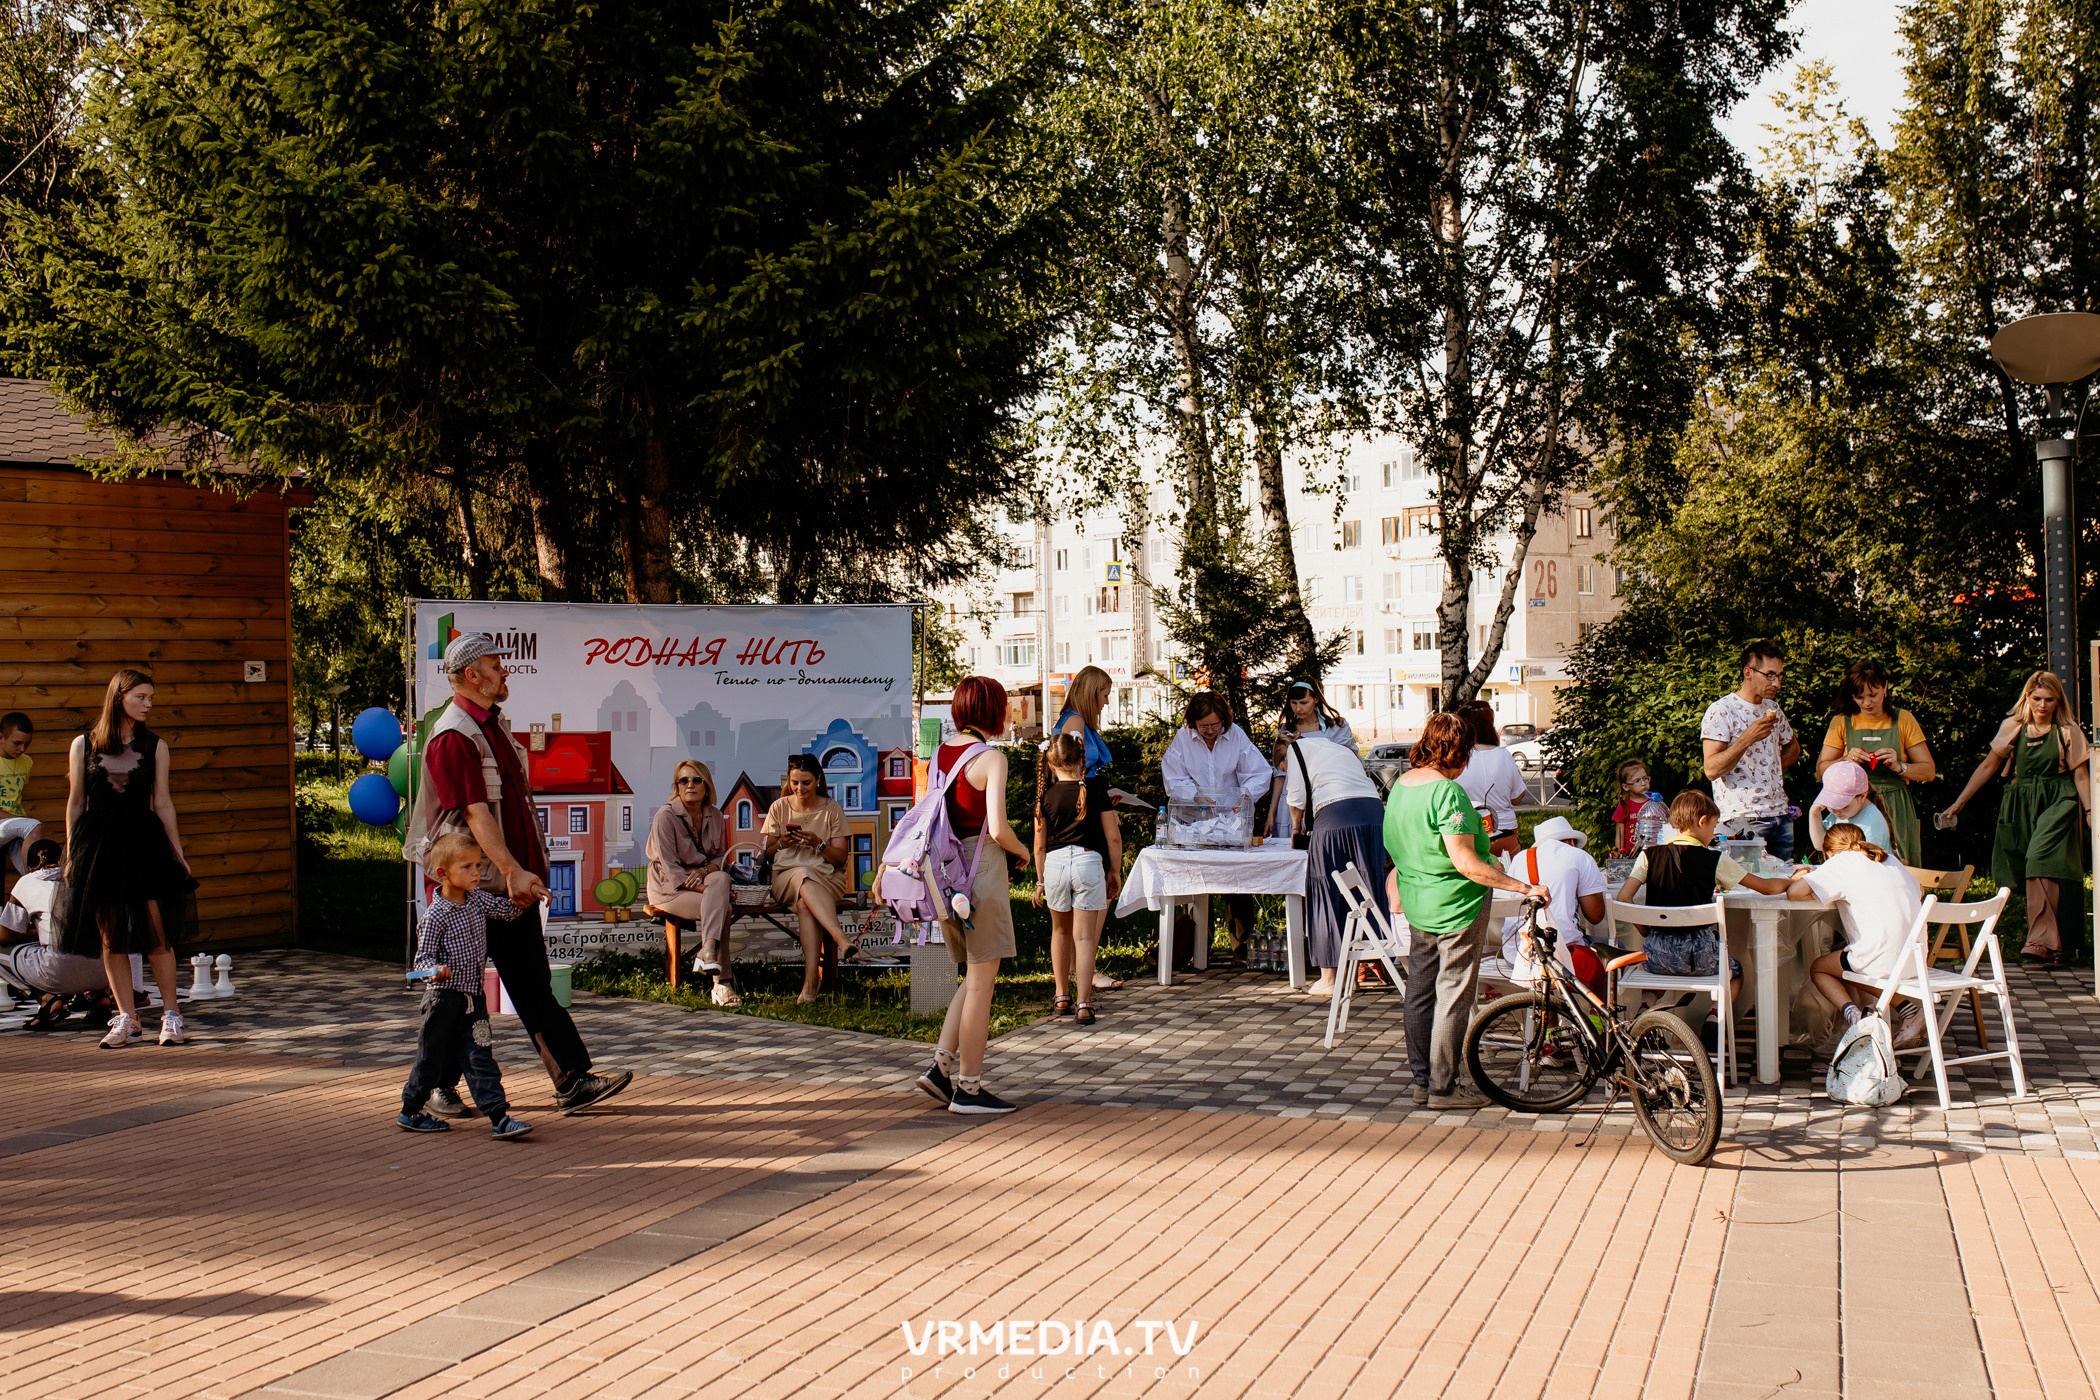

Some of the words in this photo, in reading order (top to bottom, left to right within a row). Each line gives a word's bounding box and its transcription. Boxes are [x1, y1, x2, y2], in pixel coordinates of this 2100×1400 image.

[1534, 560, 1557, 598] 26
[583, 636, 727, 667] РОДНАЯ
[736, 636, 826, 666] НИТЬ
[714, 670, 761, 686] Тепло
[767, 669, 896, 691] по-домашнему
[562, 929, 659, 947] Строителей,
